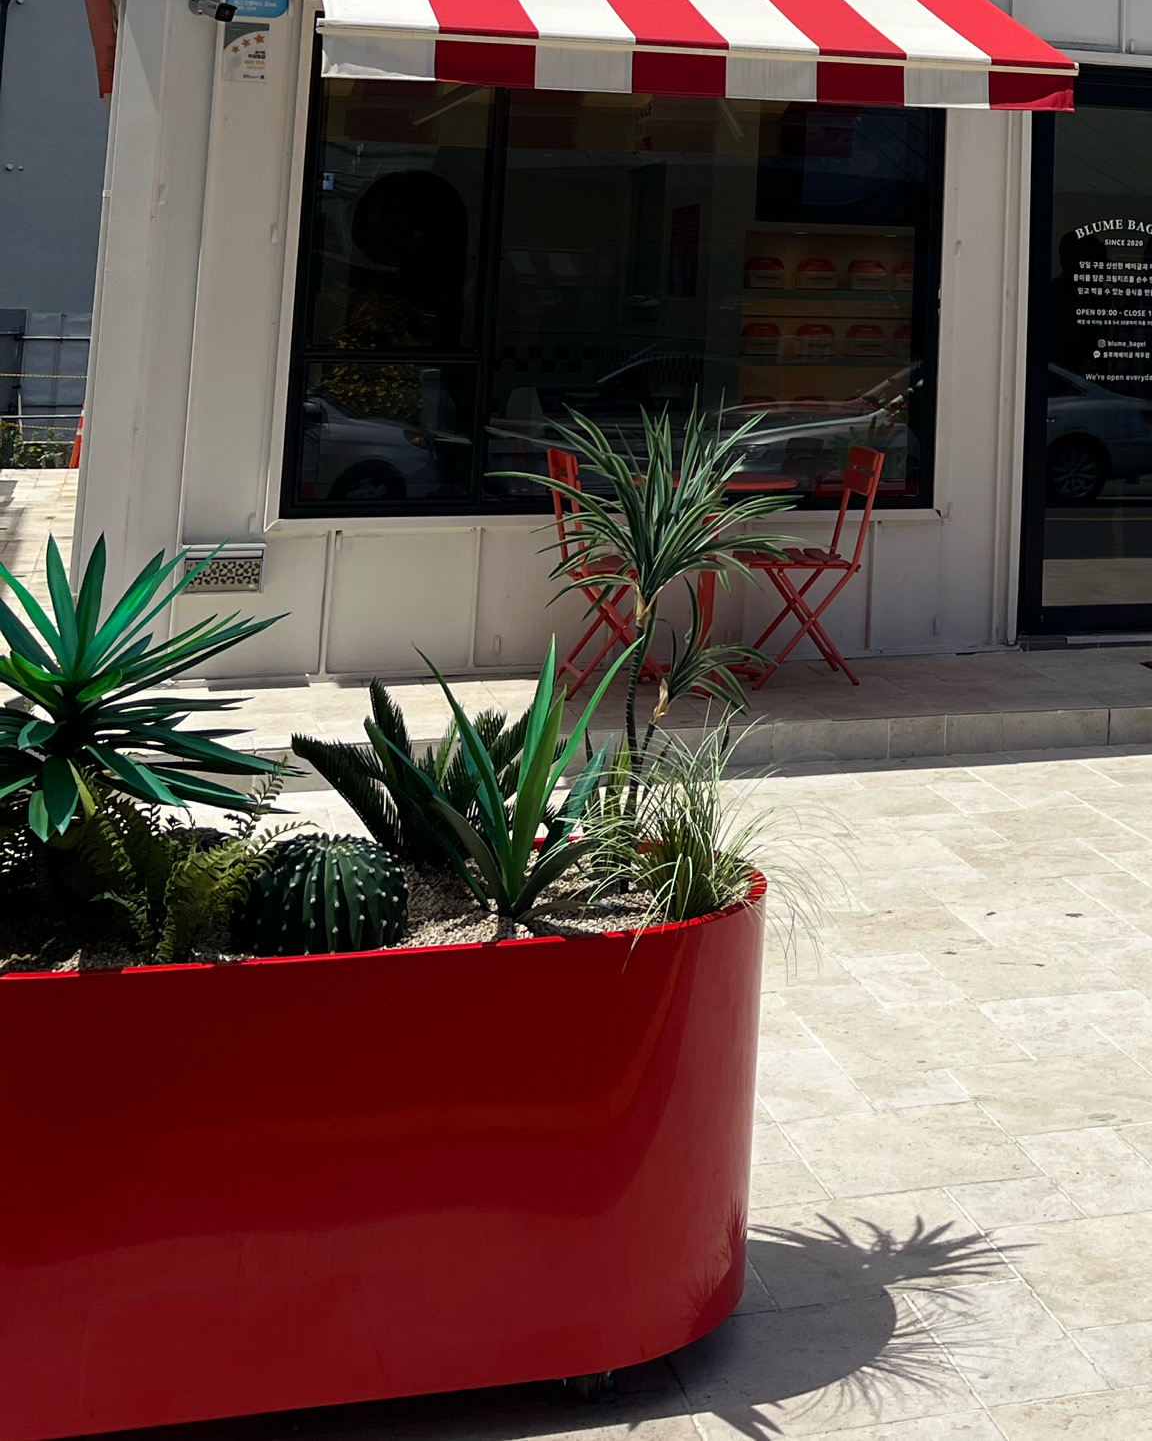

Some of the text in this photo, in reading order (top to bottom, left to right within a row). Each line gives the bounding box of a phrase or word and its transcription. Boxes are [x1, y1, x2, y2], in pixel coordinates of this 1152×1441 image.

[1075, 219, 1123, 239] BLUME
[1076, 308, 1095, 316] OPEN
[1123, 309, 1146, 317] CLOSE
[1085, 373, 1105, 381] We're
[1106, 374, 1124, 382] open
